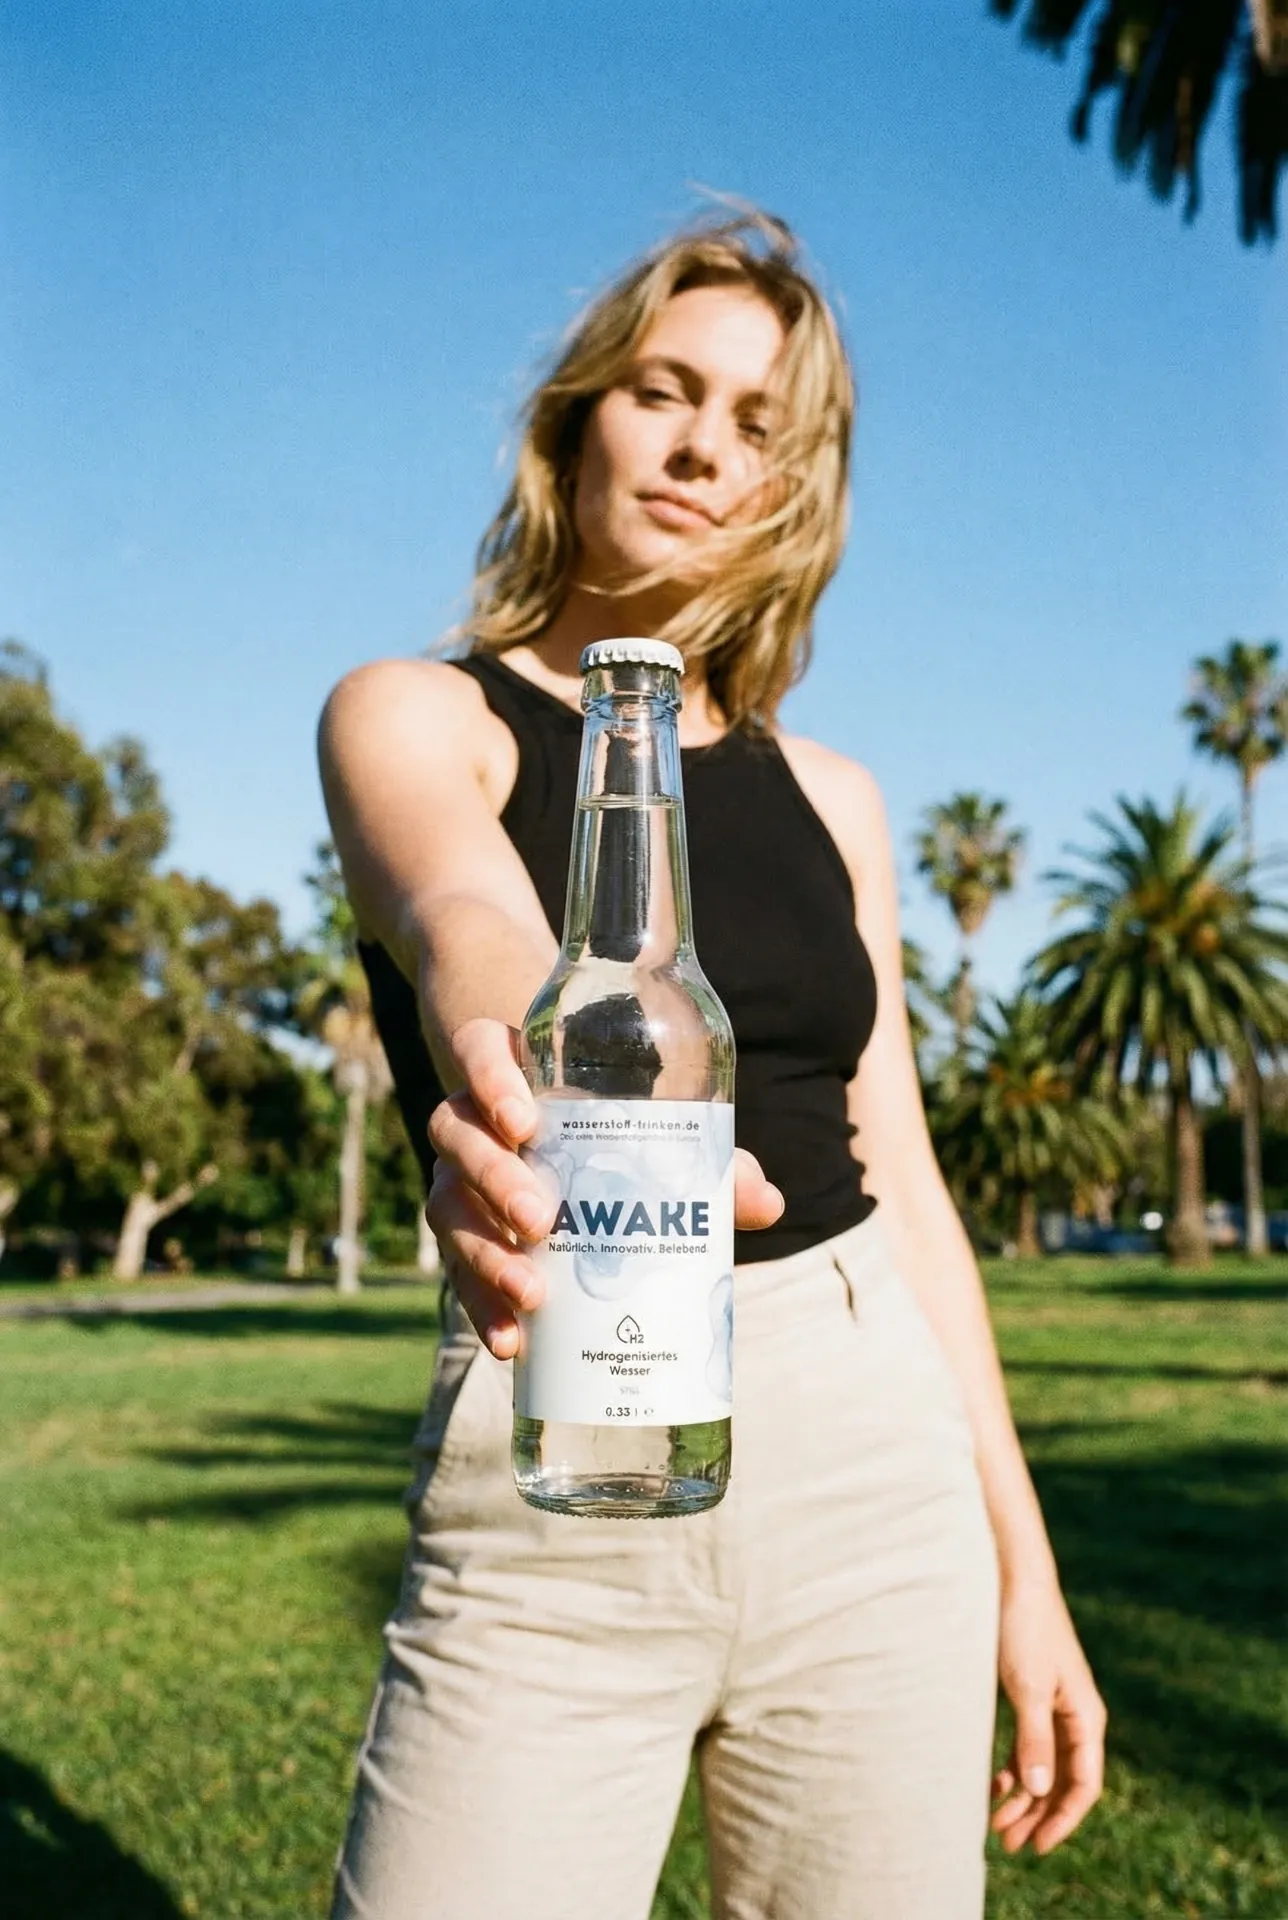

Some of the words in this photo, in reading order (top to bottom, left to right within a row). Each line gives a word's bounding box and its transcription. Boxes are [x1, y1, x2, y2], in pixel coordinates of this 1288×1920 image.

[549, 1200, 709, 1236] AWAKE
[548, 1241, 597, 1253] Natürlich.
[601, 1243, 656, 1254] Innovativ.
[629, 1334, 644, 1344] H2
[582, 1350, 678, 1363] Hydrogenisiertes
[609, 1366, 650, 1376] Wesser
[605, 1407, 630, 1417] 0.33
